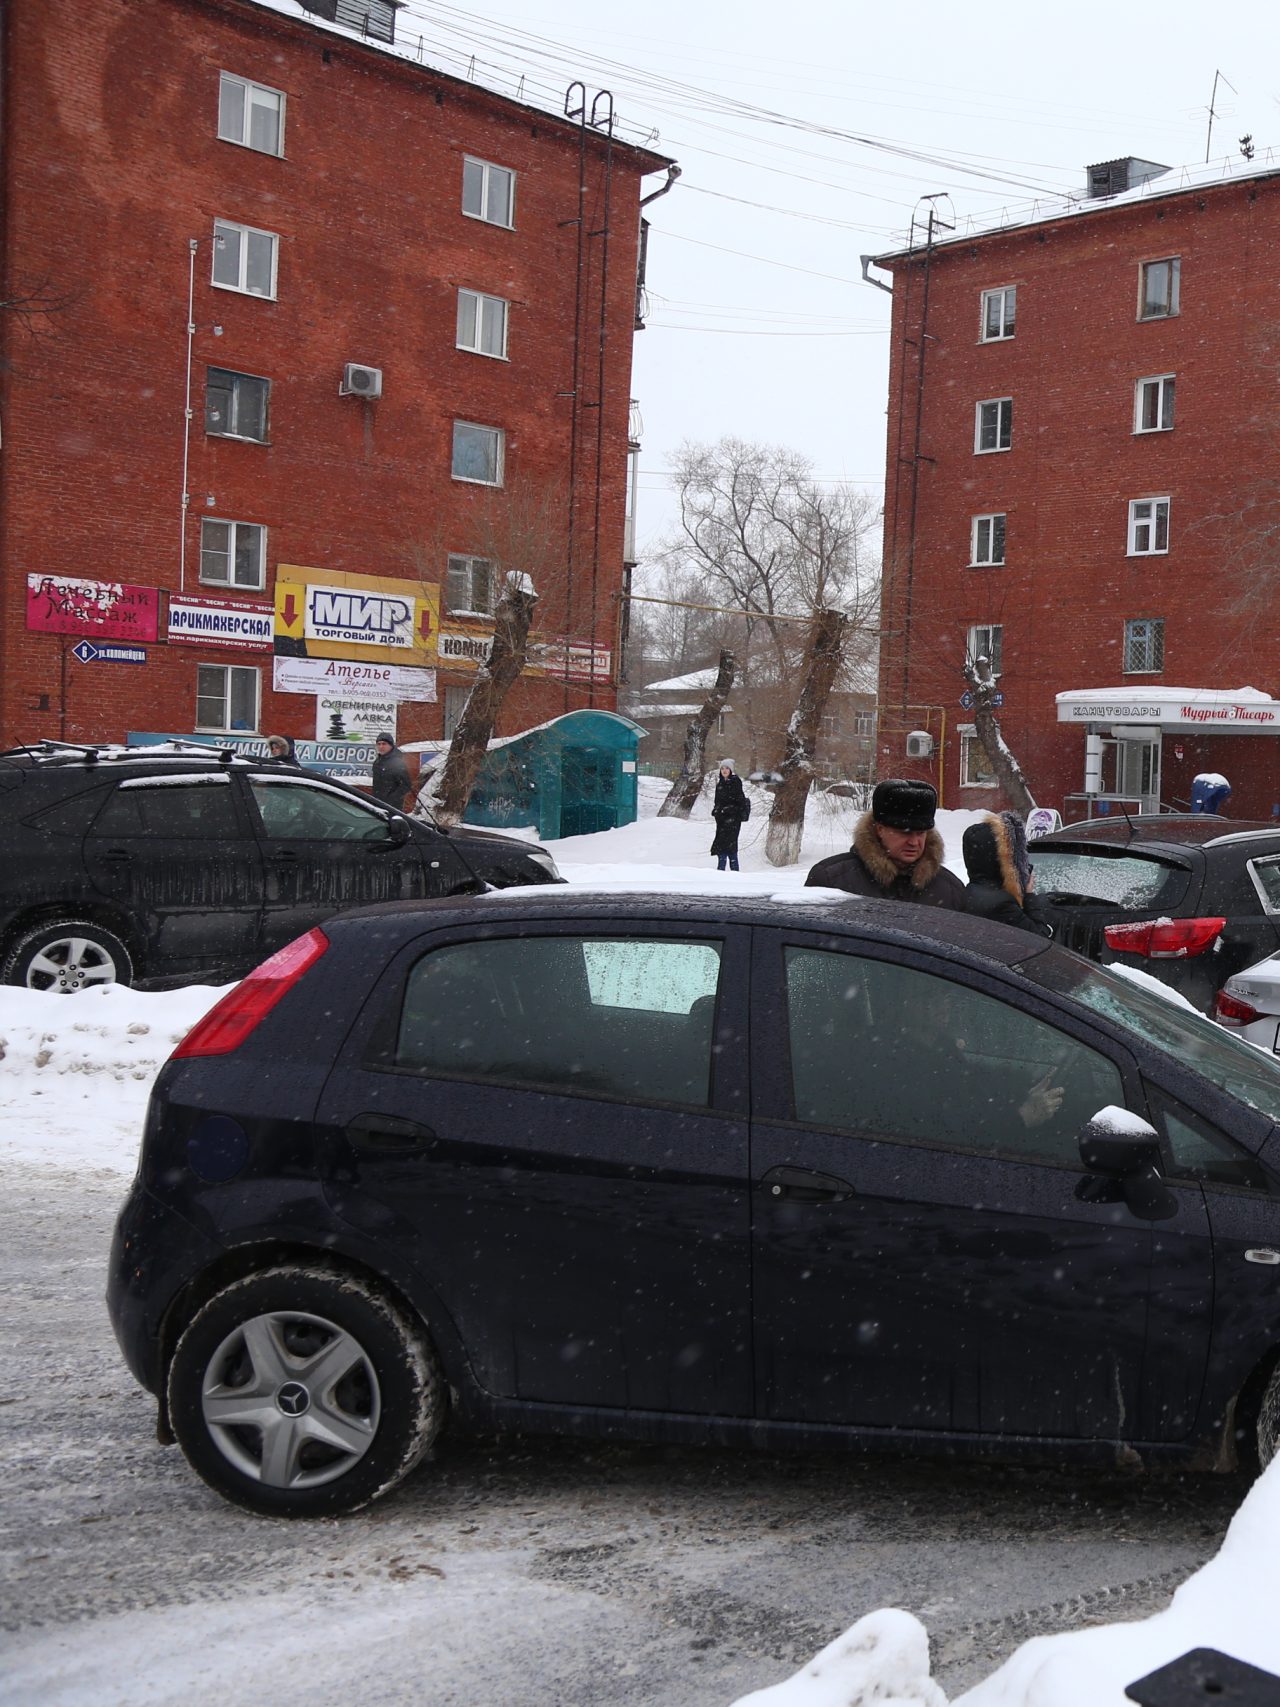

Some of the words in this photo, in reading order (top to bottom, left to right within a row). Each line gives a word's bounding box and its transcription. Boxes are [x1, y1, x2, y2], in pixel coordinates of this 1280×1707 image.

[46, 597, 137, 623] Массаж
[312, 590, 410, 633] МИР
[315, 628, 376, 642] ТОРГОВЫЙ
[379, 634, 405, 645] ДОМ
[81, 646, 88, 658] 6
[325, 661, 391, 681] Ателье
[321, 699, 395, 713] СУВЕНИРНАЯ
[1073, 706, 1161, 717] КАНЦТОВАРЫ
[1181, 705, 1228, 721] Мудрый
[1231, 704, 1275, 723] Писарь
[353, 713, 395, 725] ЛАВКА
[315, 746, 377, 762] КОВРОВ
